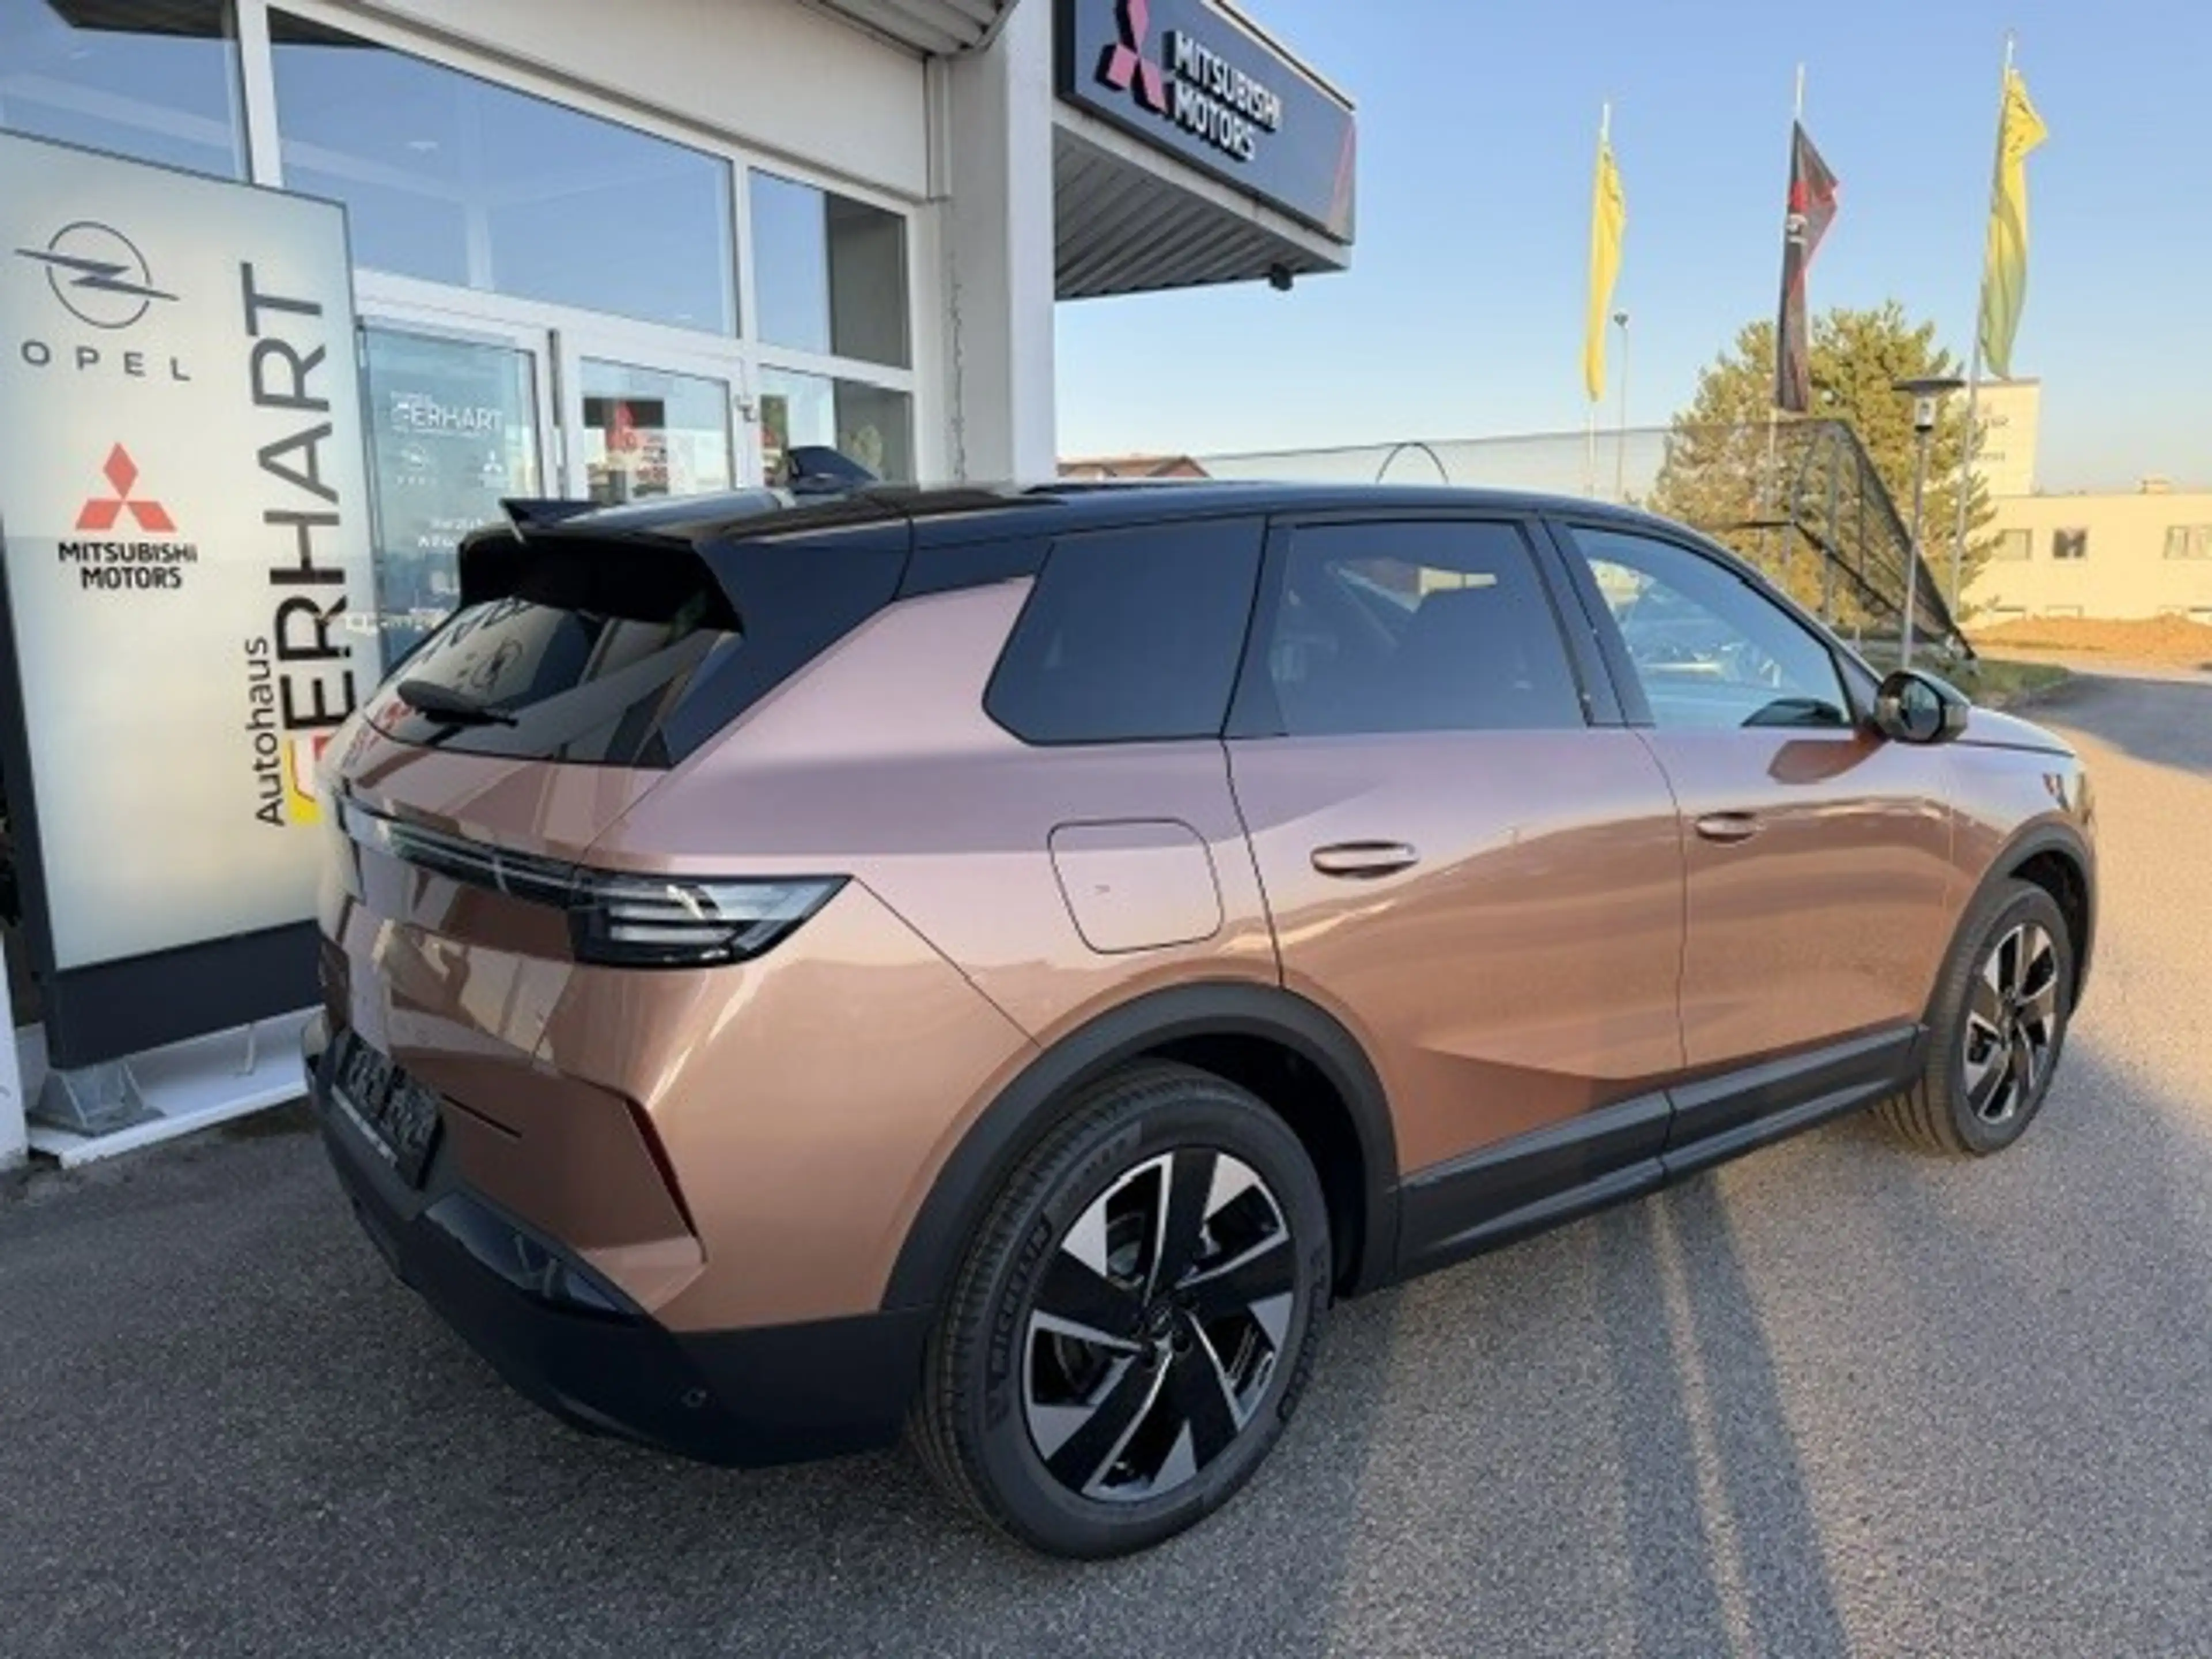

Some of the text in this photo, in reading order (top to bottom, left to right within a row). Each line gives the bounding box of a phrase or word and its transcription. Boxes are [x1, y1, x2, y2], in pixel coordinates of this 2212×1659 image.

[1175, 30, 1283, 130] MITSUBISHI
[1175, 79, 1255, 161] MOTORS
[21, 340, 191, 381] OPEL
[58, 541, 198, 563] MITSUBISHI
[81, 566, 183, 589] MOTORS
[245, 637, 285, 828] Autohaus
